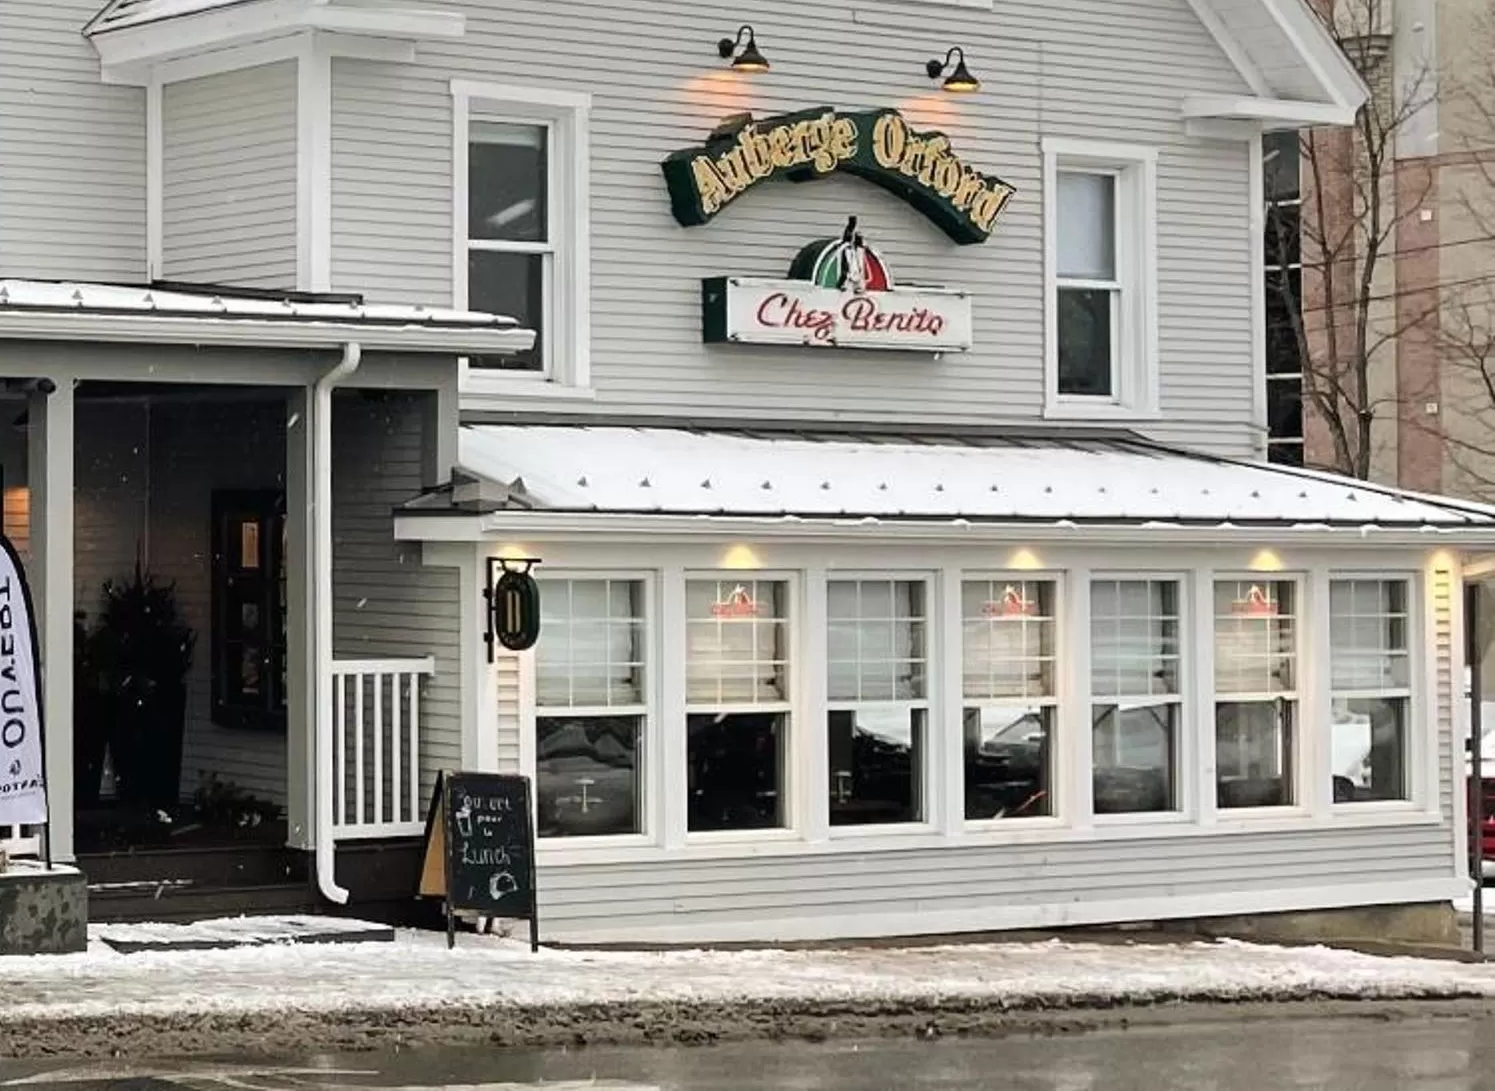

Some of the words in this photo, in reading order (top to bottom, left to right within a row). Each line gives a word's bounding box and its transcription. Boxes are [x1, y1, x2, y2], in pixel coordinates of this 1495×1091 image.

[691, 112, 859, 214] Auberge
[872, 113, 1015, 233] Orford
[756, 292, 836, 340] Chez
[841, 296, 945, 336] Benito
